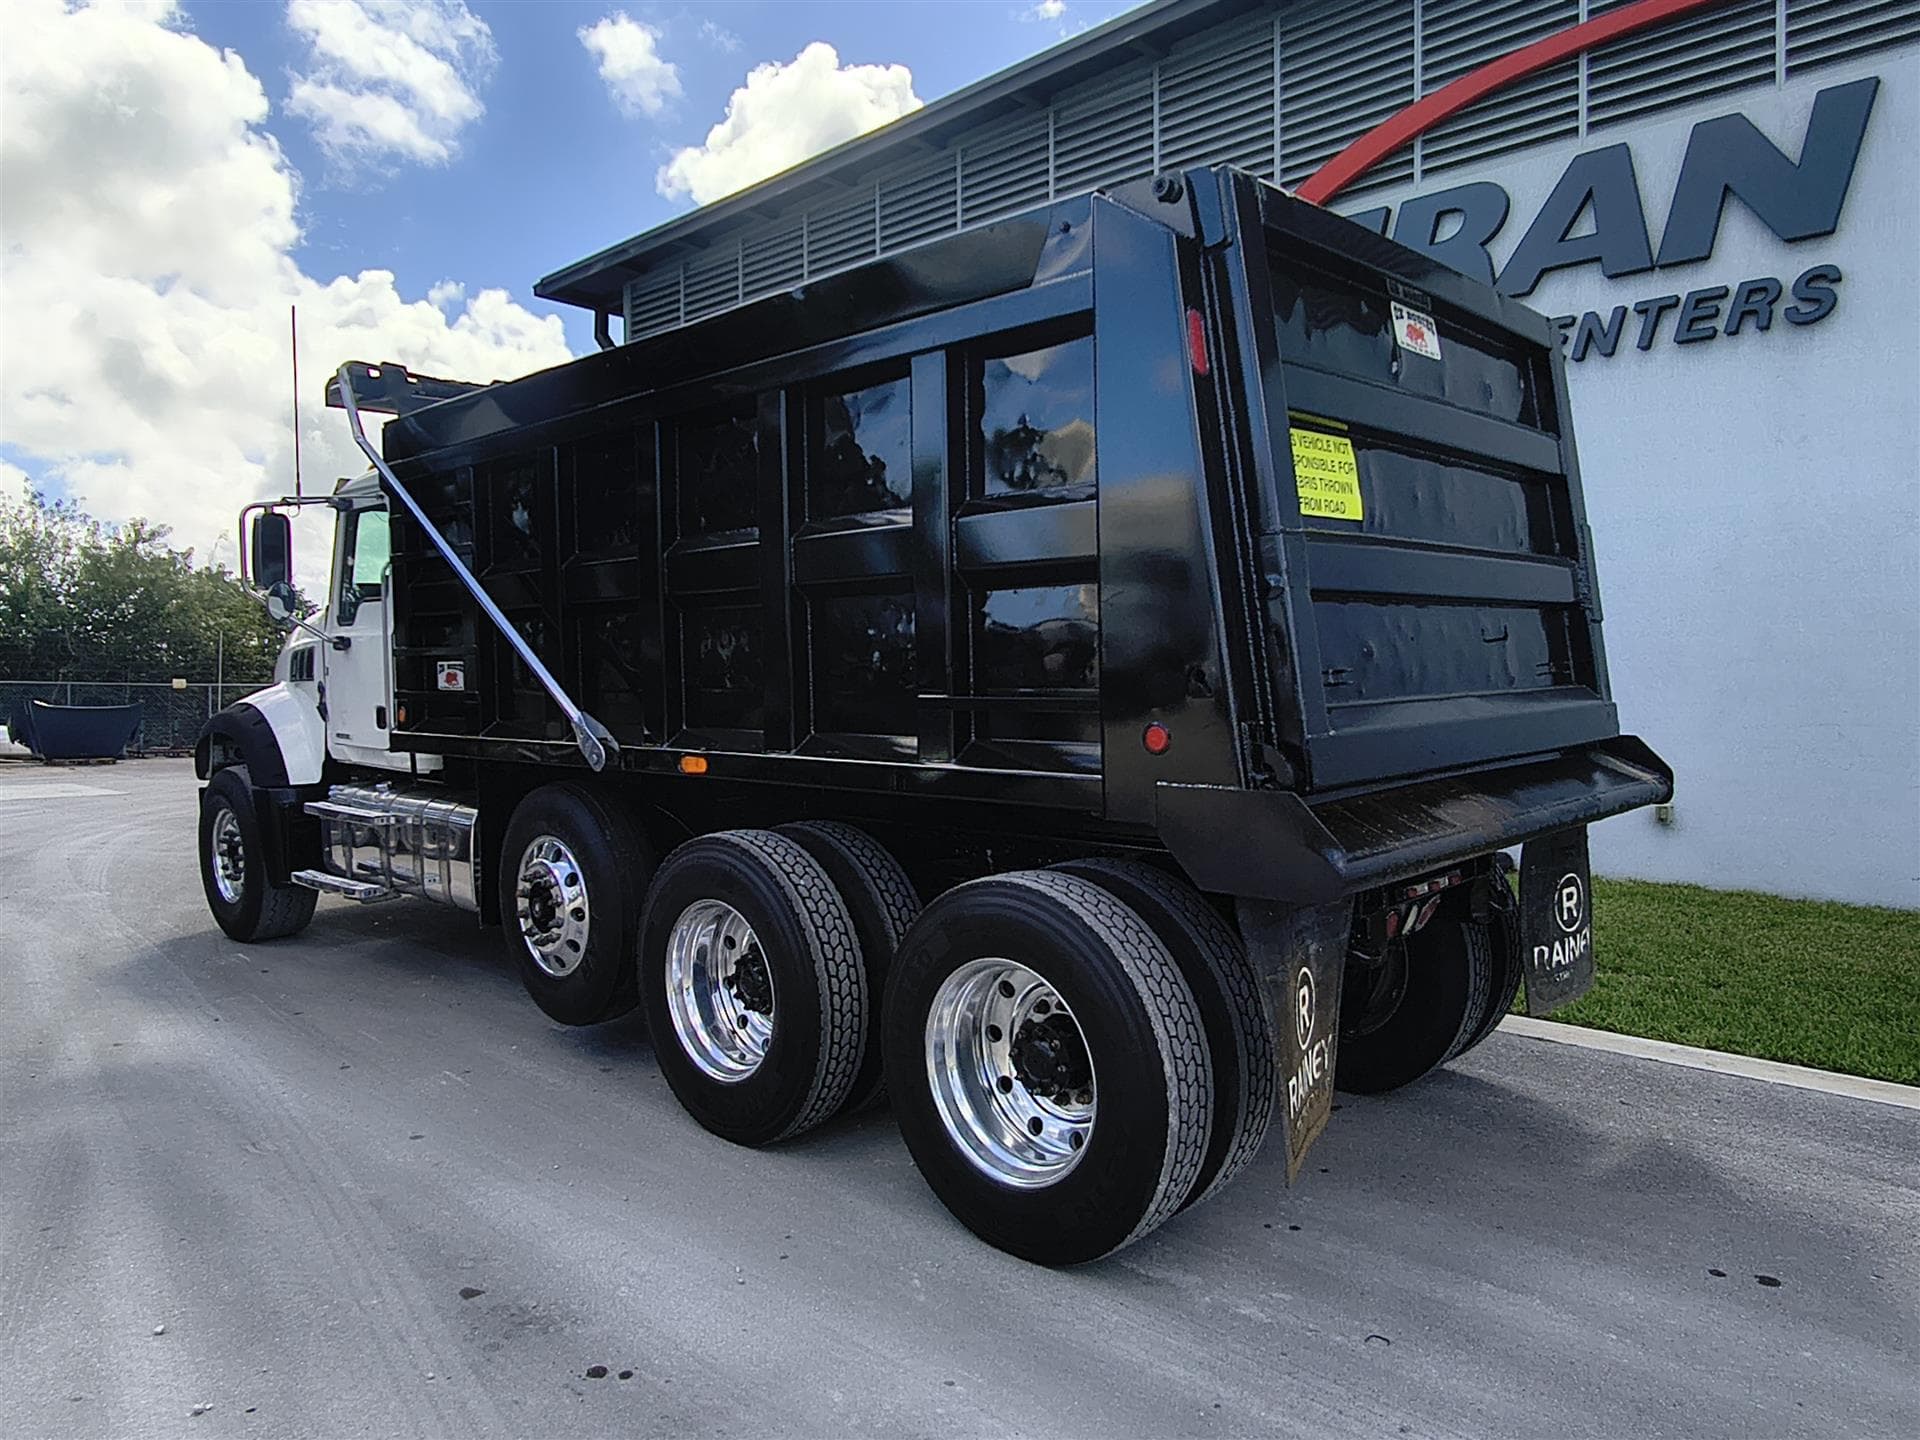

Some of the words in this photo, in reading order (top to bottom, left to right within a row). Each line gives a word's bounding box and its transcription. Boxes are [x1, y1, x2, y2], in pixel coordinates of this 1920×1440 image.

[1345, 76, 1880, 298] RAN
[1297, 435, 1333, 453] VEHICLE
[1334, 441, 1350, 455] NOT
[1292, 454, 1337, 473] PONSIBLE
[1338, 460, 1355, 475] FOR
[1319, 477, 1353, 495] THROWN
[1299, 496, 1322, 512] FROM
[1323, 499, 1346, 514] ROAD
[1561, 886, 1578, 921] R
[1299, 984, 1311, 1035] R
